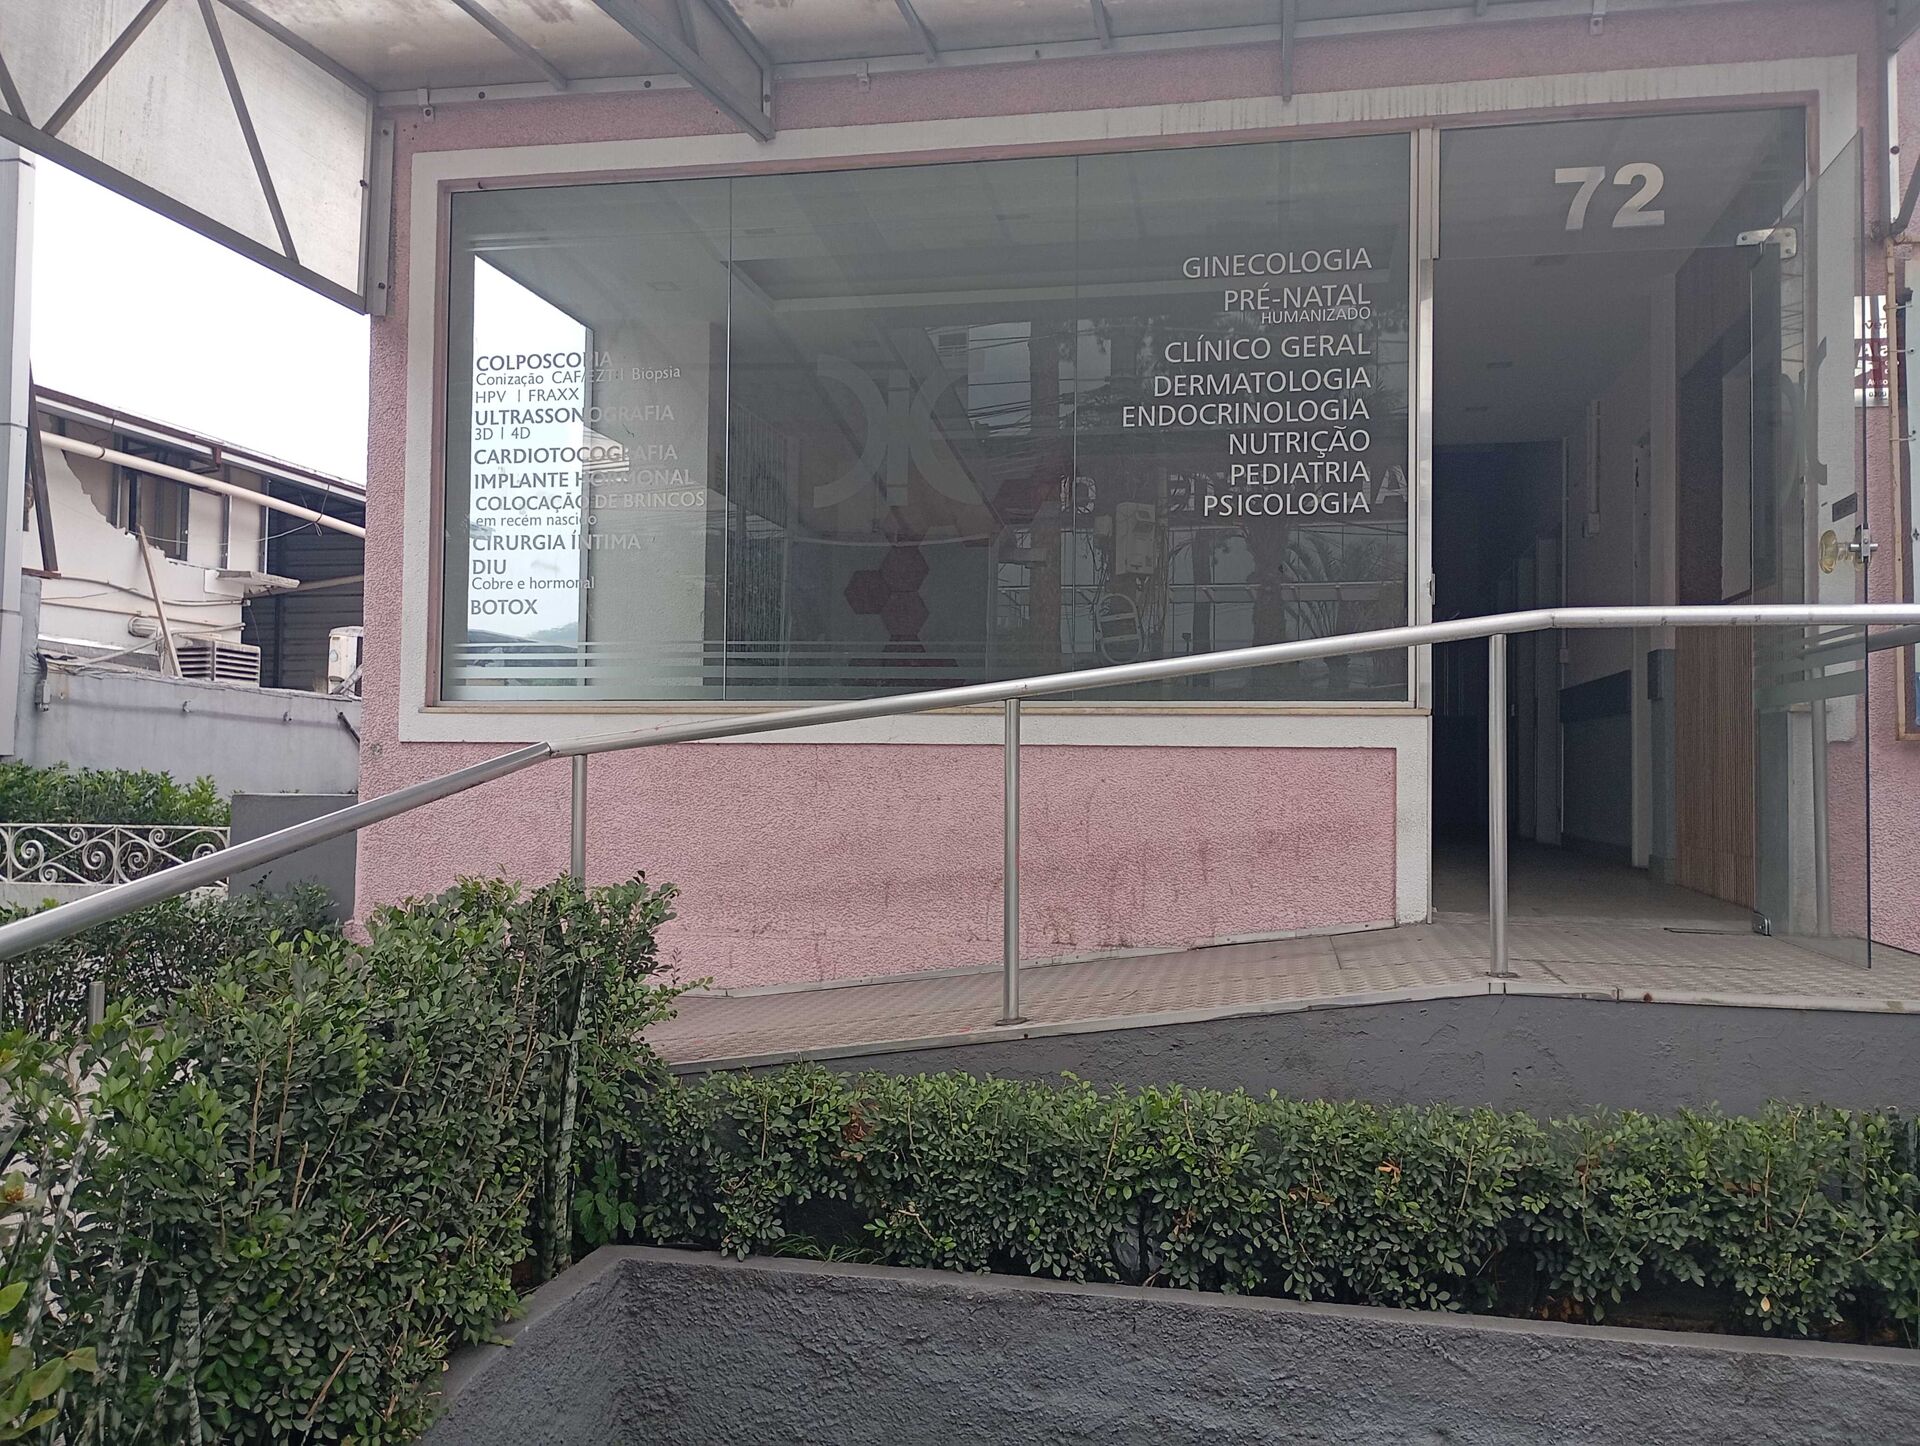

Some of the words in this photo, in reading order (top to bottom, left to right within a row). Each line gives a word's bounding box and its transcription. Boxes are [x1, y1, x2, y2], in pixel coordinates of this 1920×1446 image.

[1554, 161, 1665, 231] 72
[1182, 247, 1373, 279] GINECOLOGIA
[1224, 281, 1371, 311] PRÉ-NATAL
[1261, 306, 1371, 324] HUMANIZADO
[1164, 334, 1271, 363] CLÍNICO
[1281, 333, 1371, 358] GERAL
[476, 371, 544, 387] Conização
[632, 365, 681, 384] Biópsia
[1153, 367, 1371, 397] DERMATOLOGIA
[475, 390, 507, 403] HPV
[528, 388, 580, 402] FRAXX
[475, 404, 675, 426] ULTRASSONOGRAFIA
[1122, 398, 1370, 427] ENDOCRINOLOGIA
[475, 427, 494, 440] 3D
[510, 427, 531, 440] 4D
[1229, 425, 1371, 458] NUTRIÇÃO
[474, 472, 569, 489] IMPLANTE
[575, 469, 697, 488] HORMONAL
[1231, 460, 1371, 485] PEDIATRIA
[475, 492, 589, 514] COLOCAÇÃO
[595, 493, 618, 509] DE
[624, 491, 705, 508] BRINCOS
[1203, 491, 1371, 517] PSICOLOGIA
[476, 516, 496, 527] em
[500, 513, 542, 527] recém
[472, 534, 566, 552] CIRURGIA
[571, 529, 642, 551] ÍNTIMA
[472, 559, 507, 575] DIU
[472, 577, 514, 590] Cobre
[517, 580, 526, 590] e
[529, 576, 595, 591] hormonal
[470, 599, 539, 616] BOTOX
